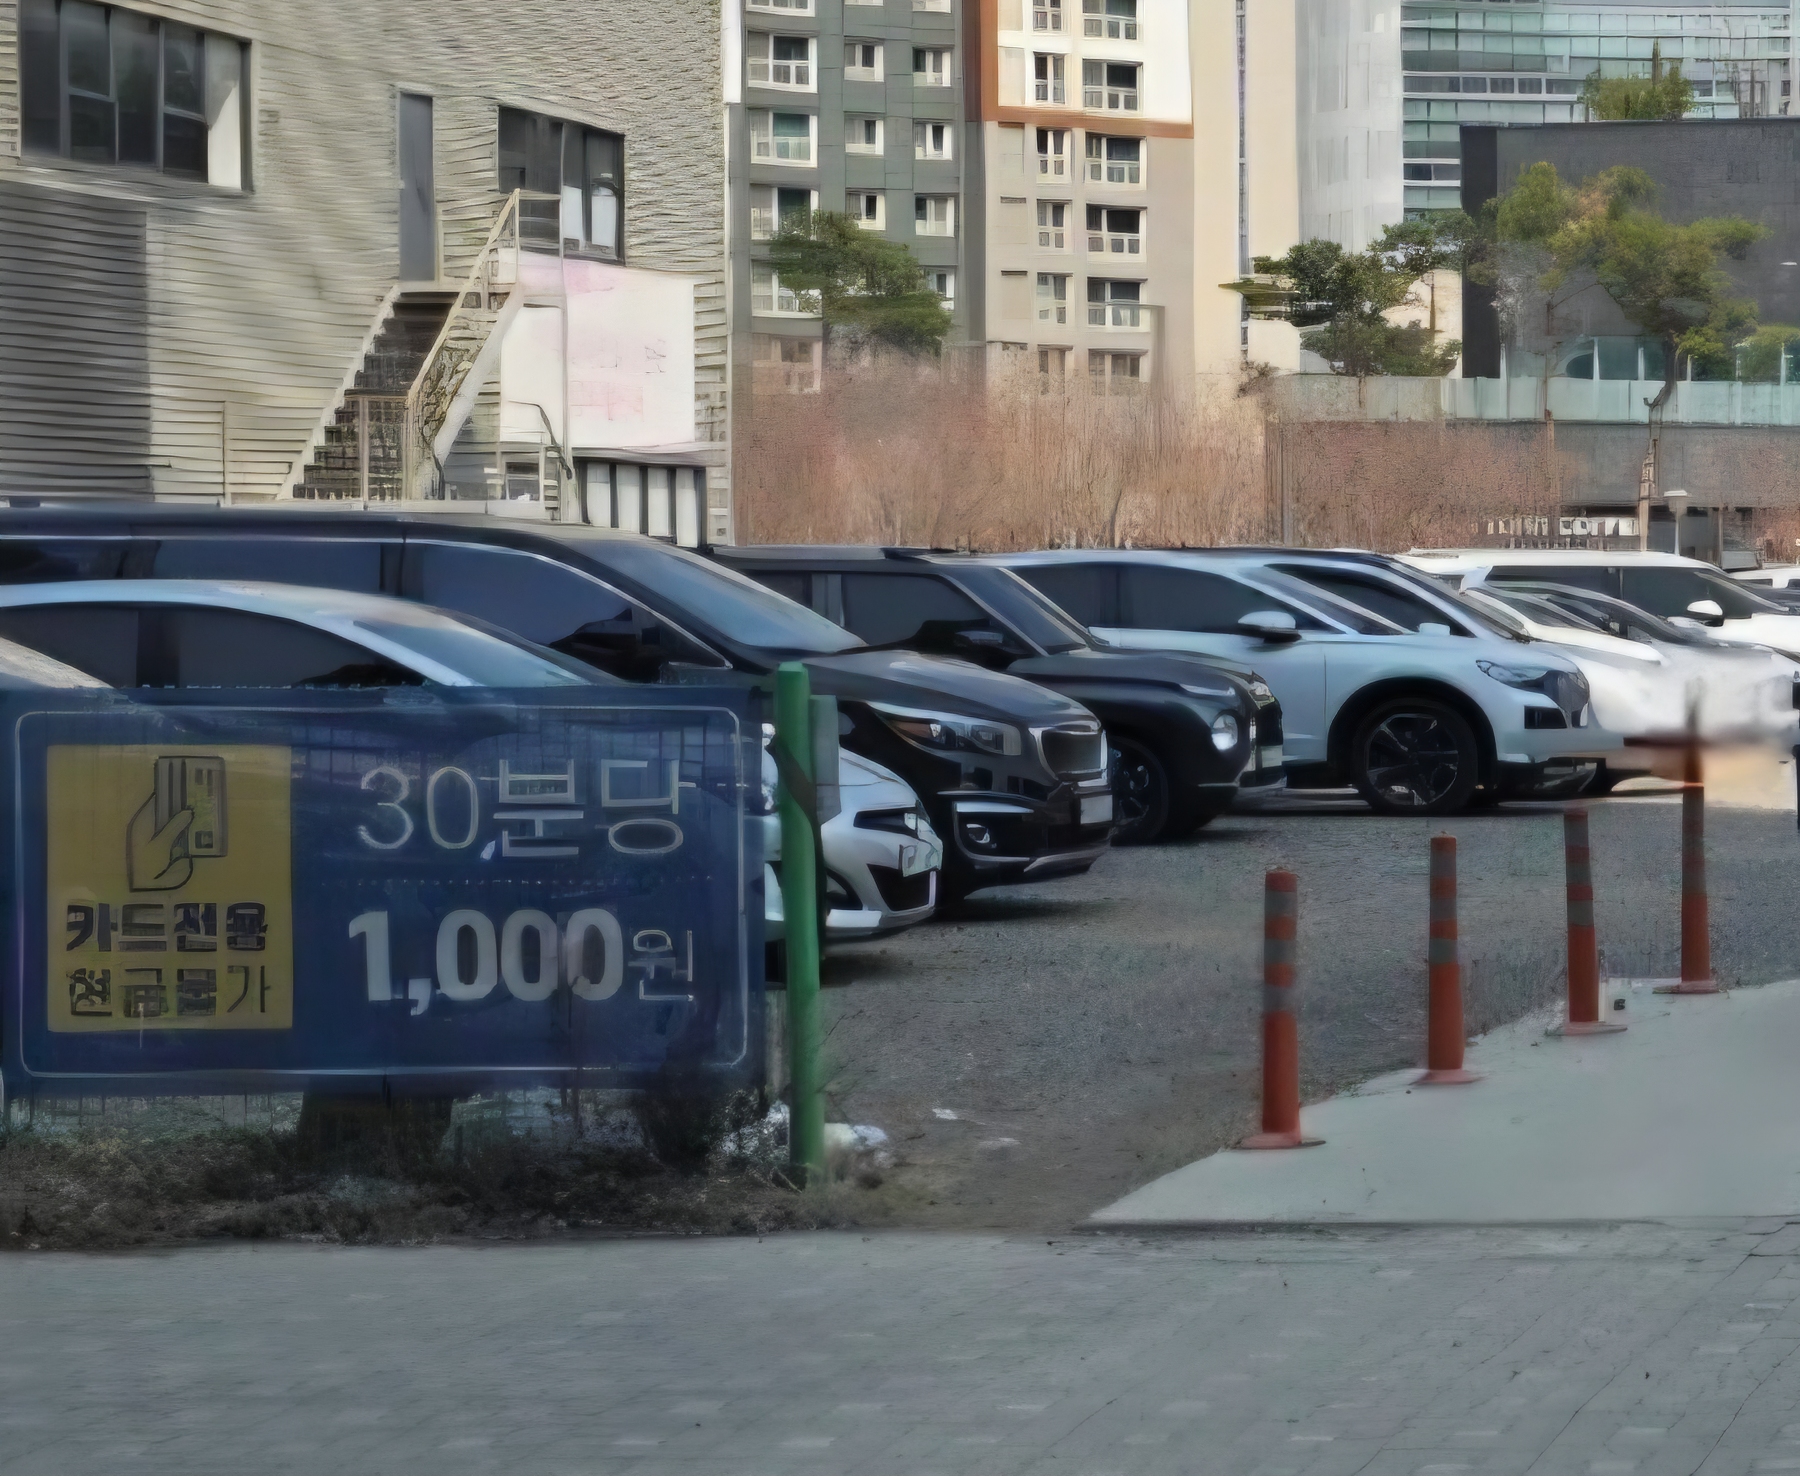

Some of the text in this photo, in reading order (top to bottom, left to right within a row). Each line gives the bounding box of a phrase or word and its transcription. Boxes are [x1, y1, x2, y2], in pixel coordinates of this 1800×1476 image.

[358, 759, 696, 858] 30분당
[66, 902, 268, 952] 카드전용
[348, 908, 695, 1016] 1,000원
